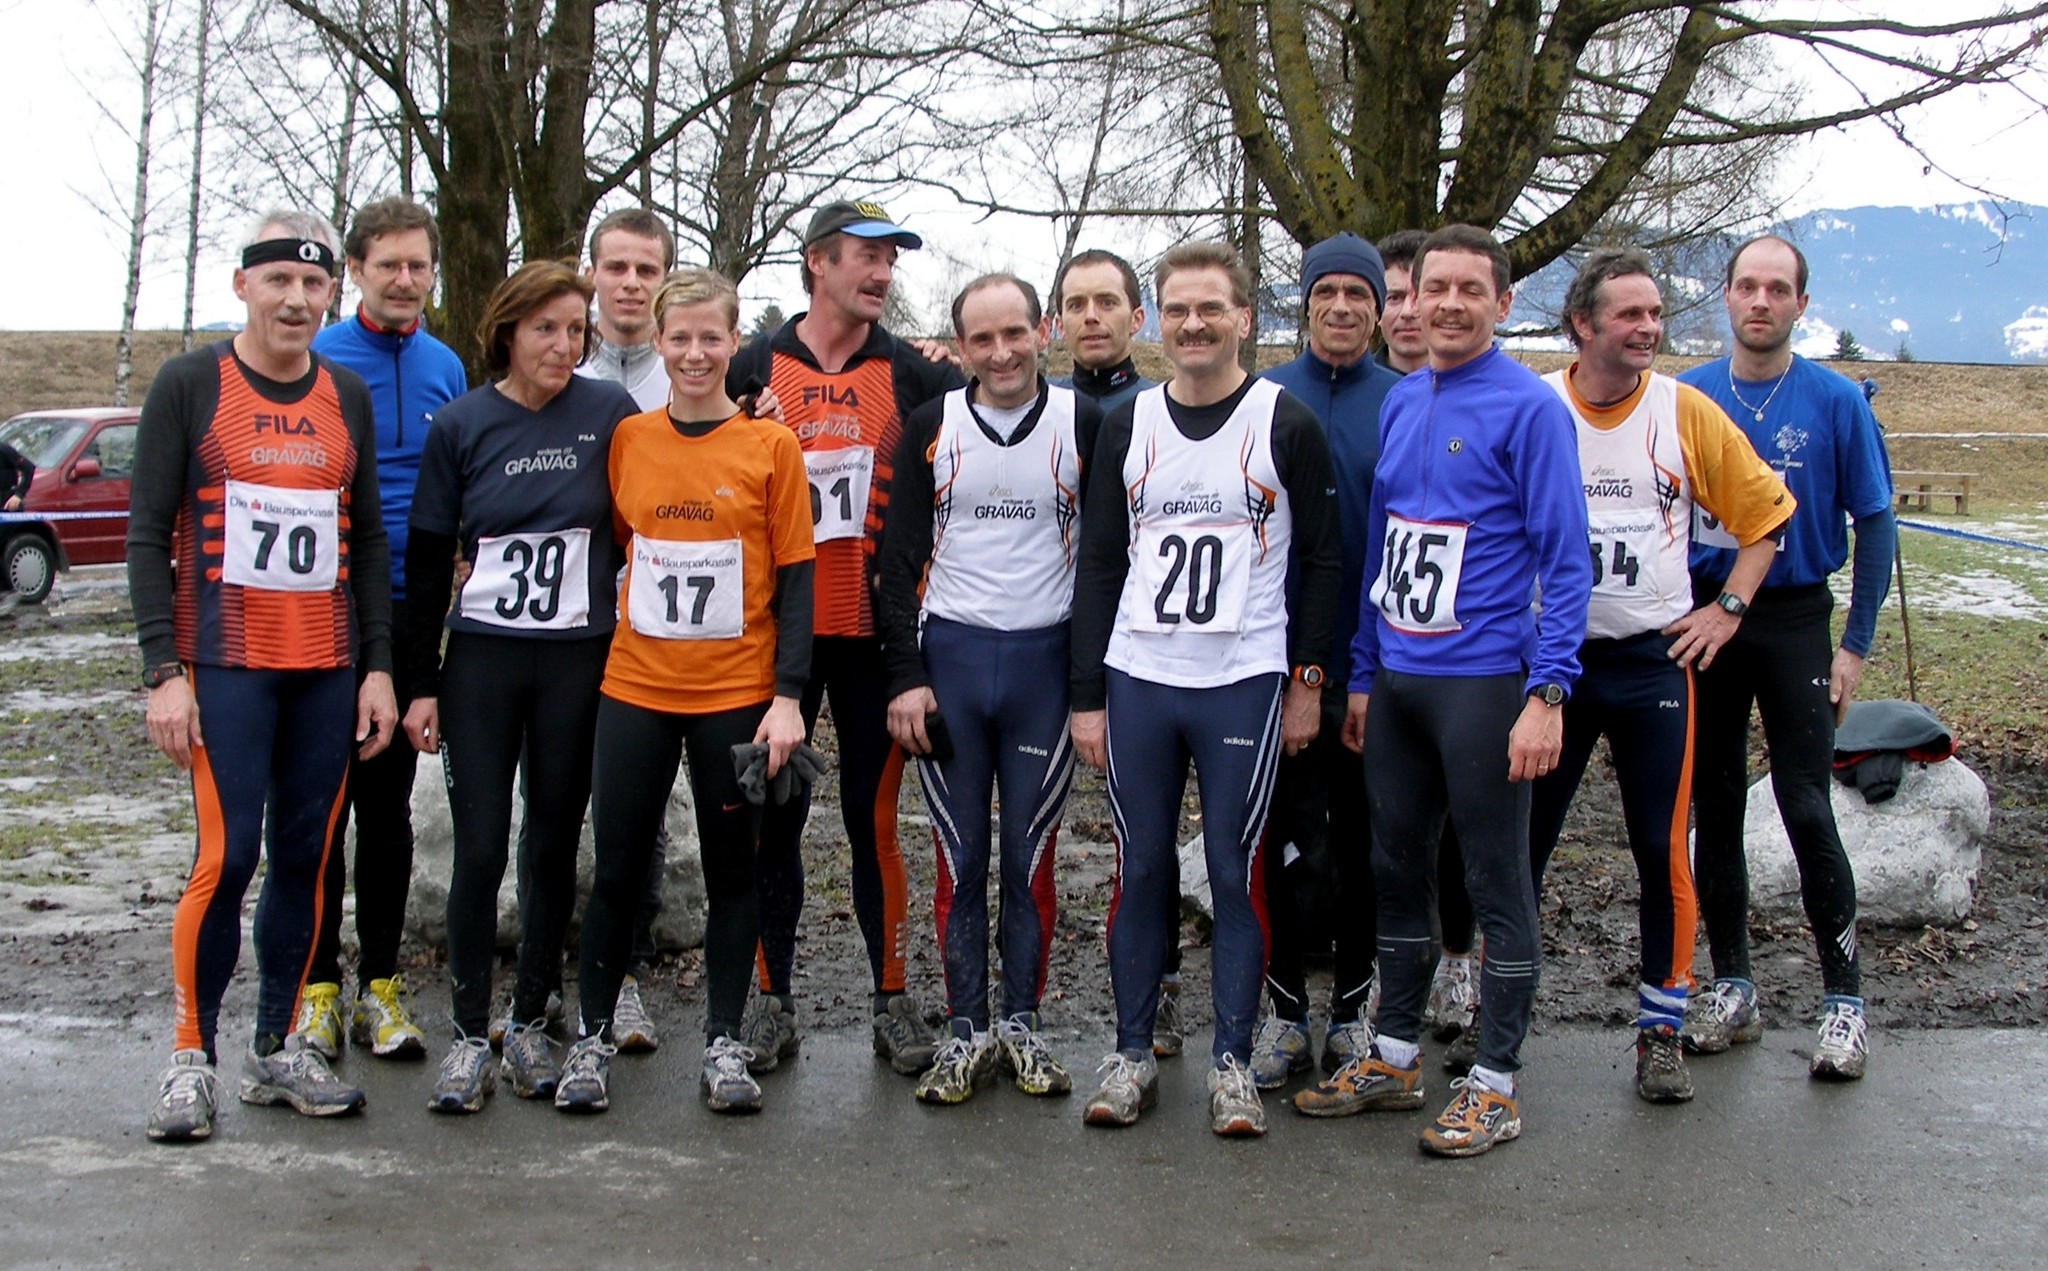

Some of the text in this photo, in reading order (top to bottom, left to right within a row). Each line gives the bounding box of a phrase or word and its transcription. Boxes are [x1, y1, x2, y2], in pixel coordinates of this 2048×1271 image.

[803, 385, 858, 407] FILA
[254, 414, 315, 436] FILA
[799, 421, 860, 439] GRAVAG
[578, 433, 595, 441] FILA
[251, 447, 326, 467] GRAVAG
[505, 454, 577, 476] GRAVAG
[1583, 485, 1633, 498] RAVAG
[230, 496, 248, 509] Die
[1163, 500, 1222, 515] GRAVAG
[656, 505, 714, 521] GRAVAG
[975, 505, 1036, 520] GRAVAG
[252, 520, 316, 574] 70
[662, 556, 737, 570] Bausparkasse
[495, 536, 566, 621] 39
[1155, 534, 1223, 624] 20
[1381, 528, 1448, 624] 145
[657, 575, 715, 625] 17
[1659, 700, 1680, 708] FILA
[1018, 744, 1048, 757] adidas
[1223, 737, 1254, 747] adidas
